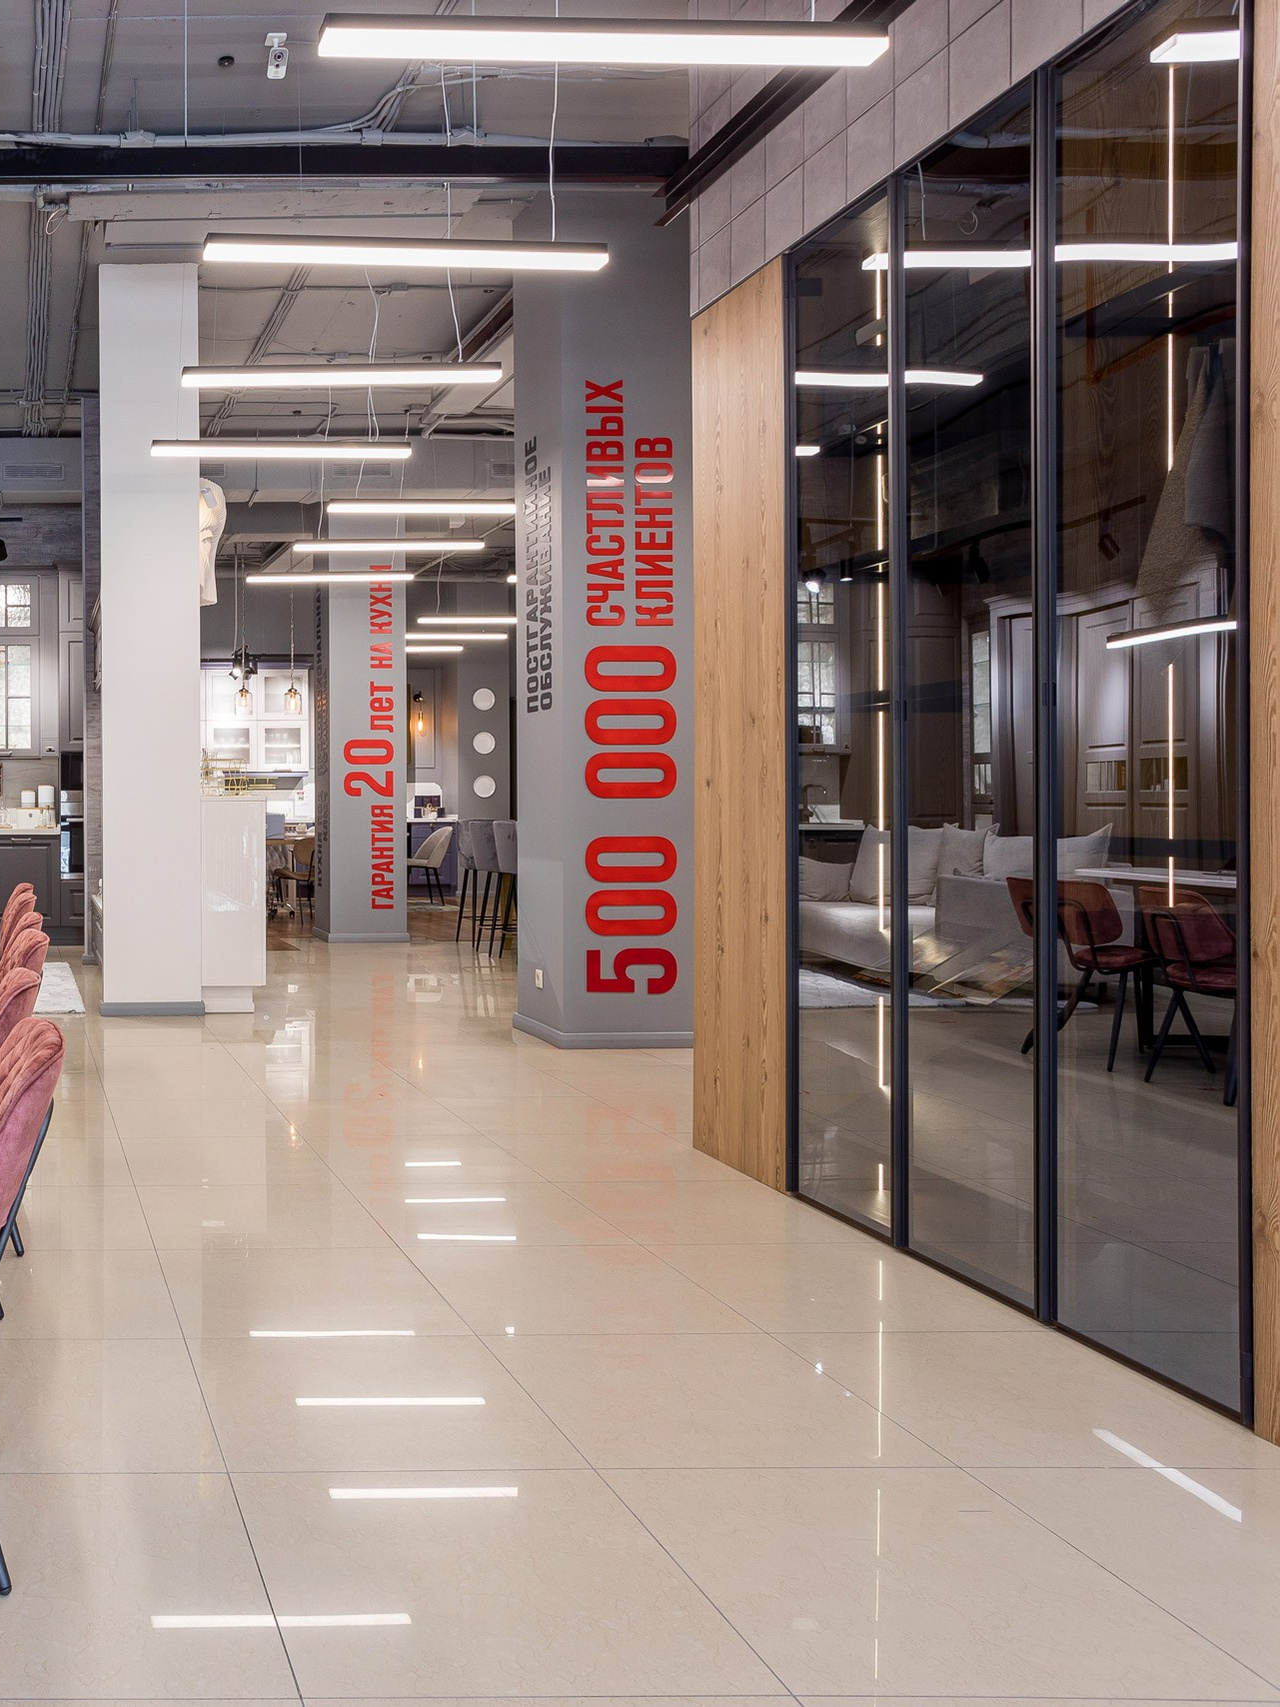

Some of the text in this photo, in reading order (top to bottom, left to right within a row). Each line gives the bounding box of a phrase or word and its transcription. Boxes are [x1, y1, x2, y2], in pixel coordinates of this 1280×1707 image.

[524, 435, 539, 713] ПОСТГАРАНТИЙНОЕ
[539, 466, 552, 711] ОБСЛУЖИВАНИЕ
[585, 379, 625, 627] СЧАСТЛИВЫХ
[634, 437, 674, 627] КЛИЕНТОВ
[370, 642, 393, 669] НА
[343, 739, 394, 797] 20
[371, 804, 394, 909] ГАРАНТИЯ
[584, 645, 678, 995] 500 000
